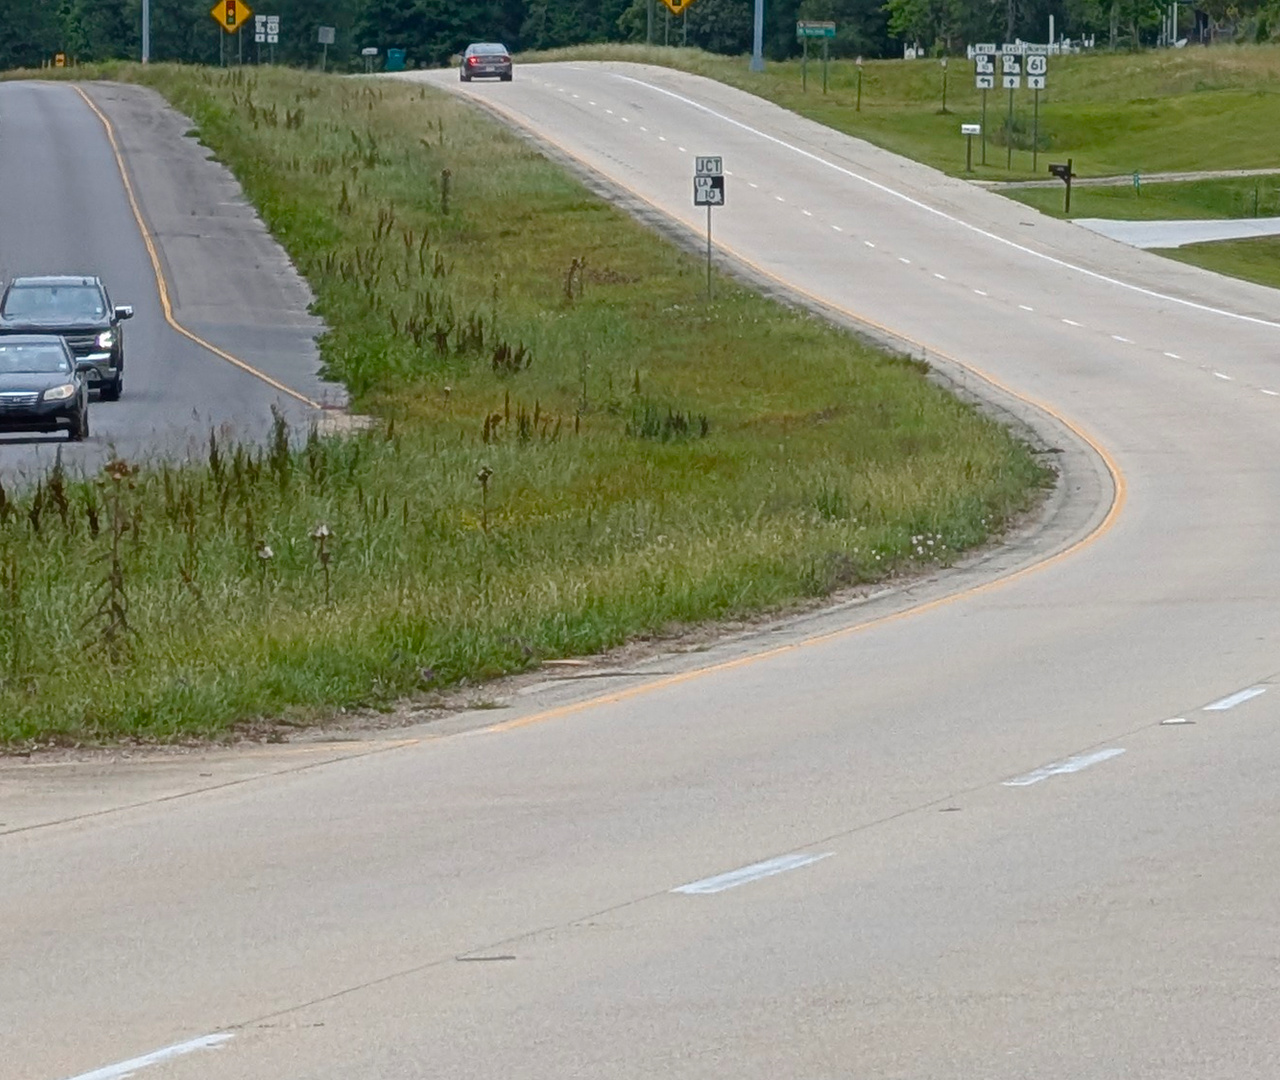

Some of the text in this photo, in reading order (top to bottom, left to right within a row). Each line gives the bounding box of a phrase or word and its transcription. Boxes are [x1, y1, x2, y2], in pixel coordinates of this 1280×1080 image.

[1030, 59, 1043, 71] 61
[696, 159, 720, 172] JCT
[698, 178, 708, 187] LA
[704, 190, 715, 199] 10
